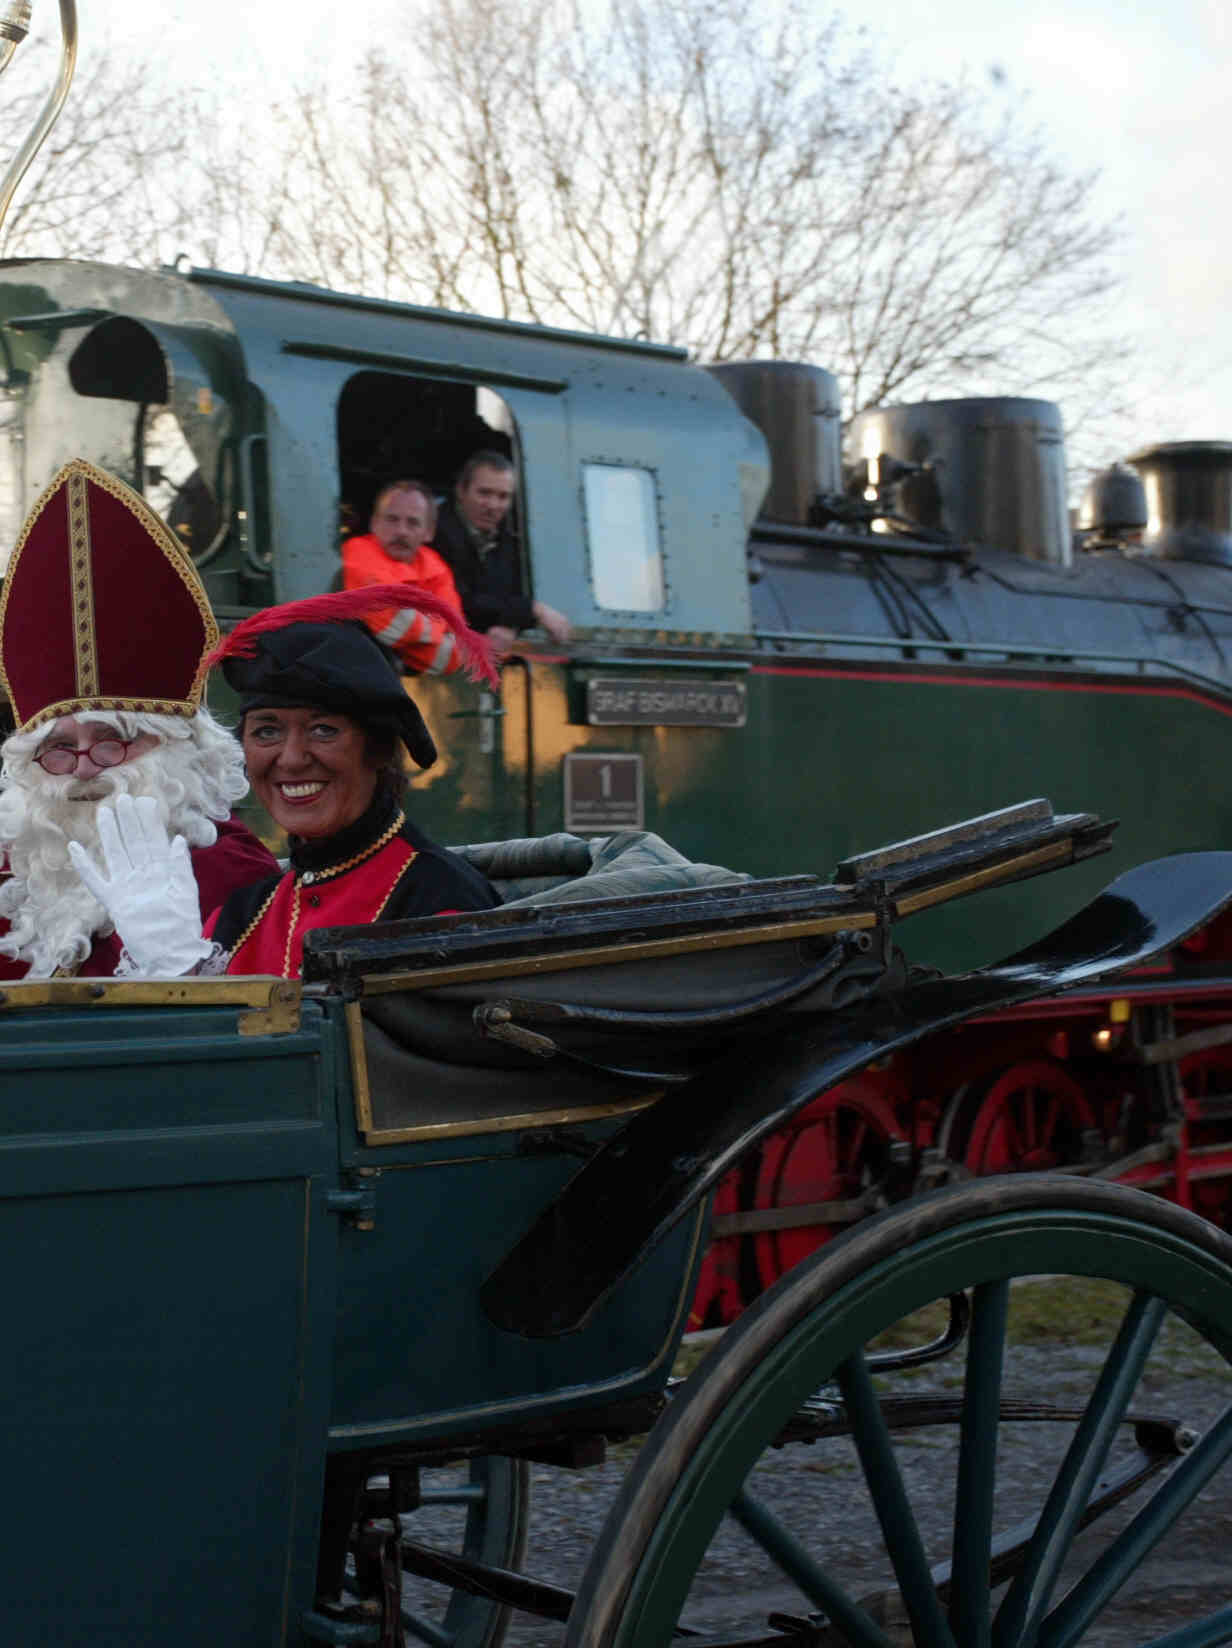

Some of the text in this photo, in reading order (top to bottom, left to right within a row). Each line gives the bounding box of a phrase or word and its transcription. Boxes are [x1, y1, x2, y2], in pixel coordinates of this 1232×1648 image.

[594, 690, 637, 712] GRAF
[639, 691, 717, 714] BISMARCK
[599, 764, 612, 798] 1
